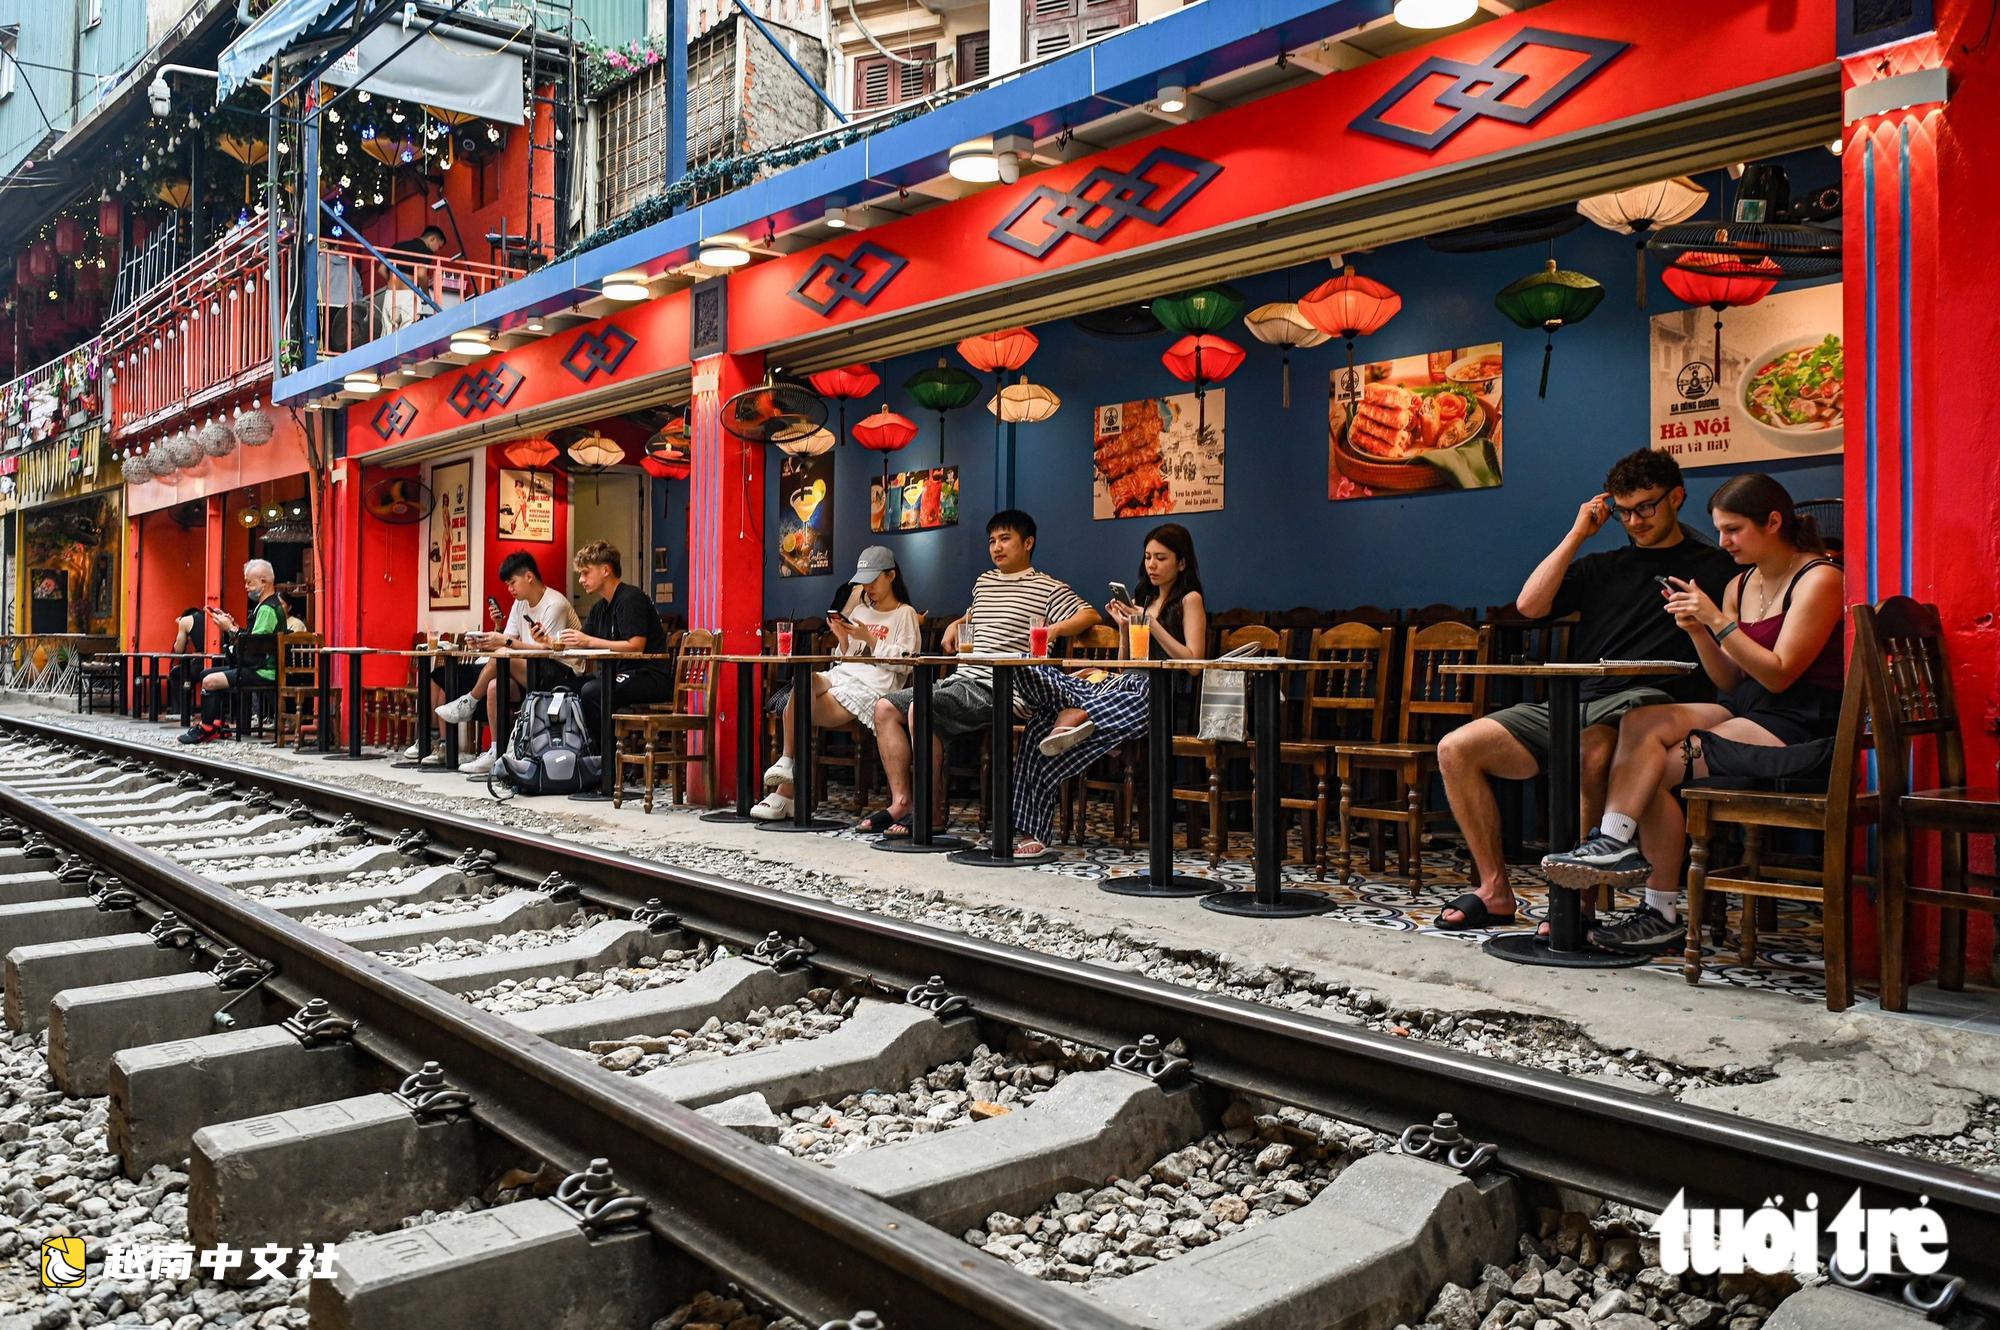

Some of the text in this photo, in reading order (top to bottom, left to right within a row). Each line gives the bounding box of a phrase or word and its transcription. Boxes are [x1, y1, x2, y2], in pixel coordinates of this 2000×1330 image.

[1660, 416, 1731, 440] Hà Nội
[1688, 440, 1702, 452] và
[1707, 438, 1731, 452] nay
